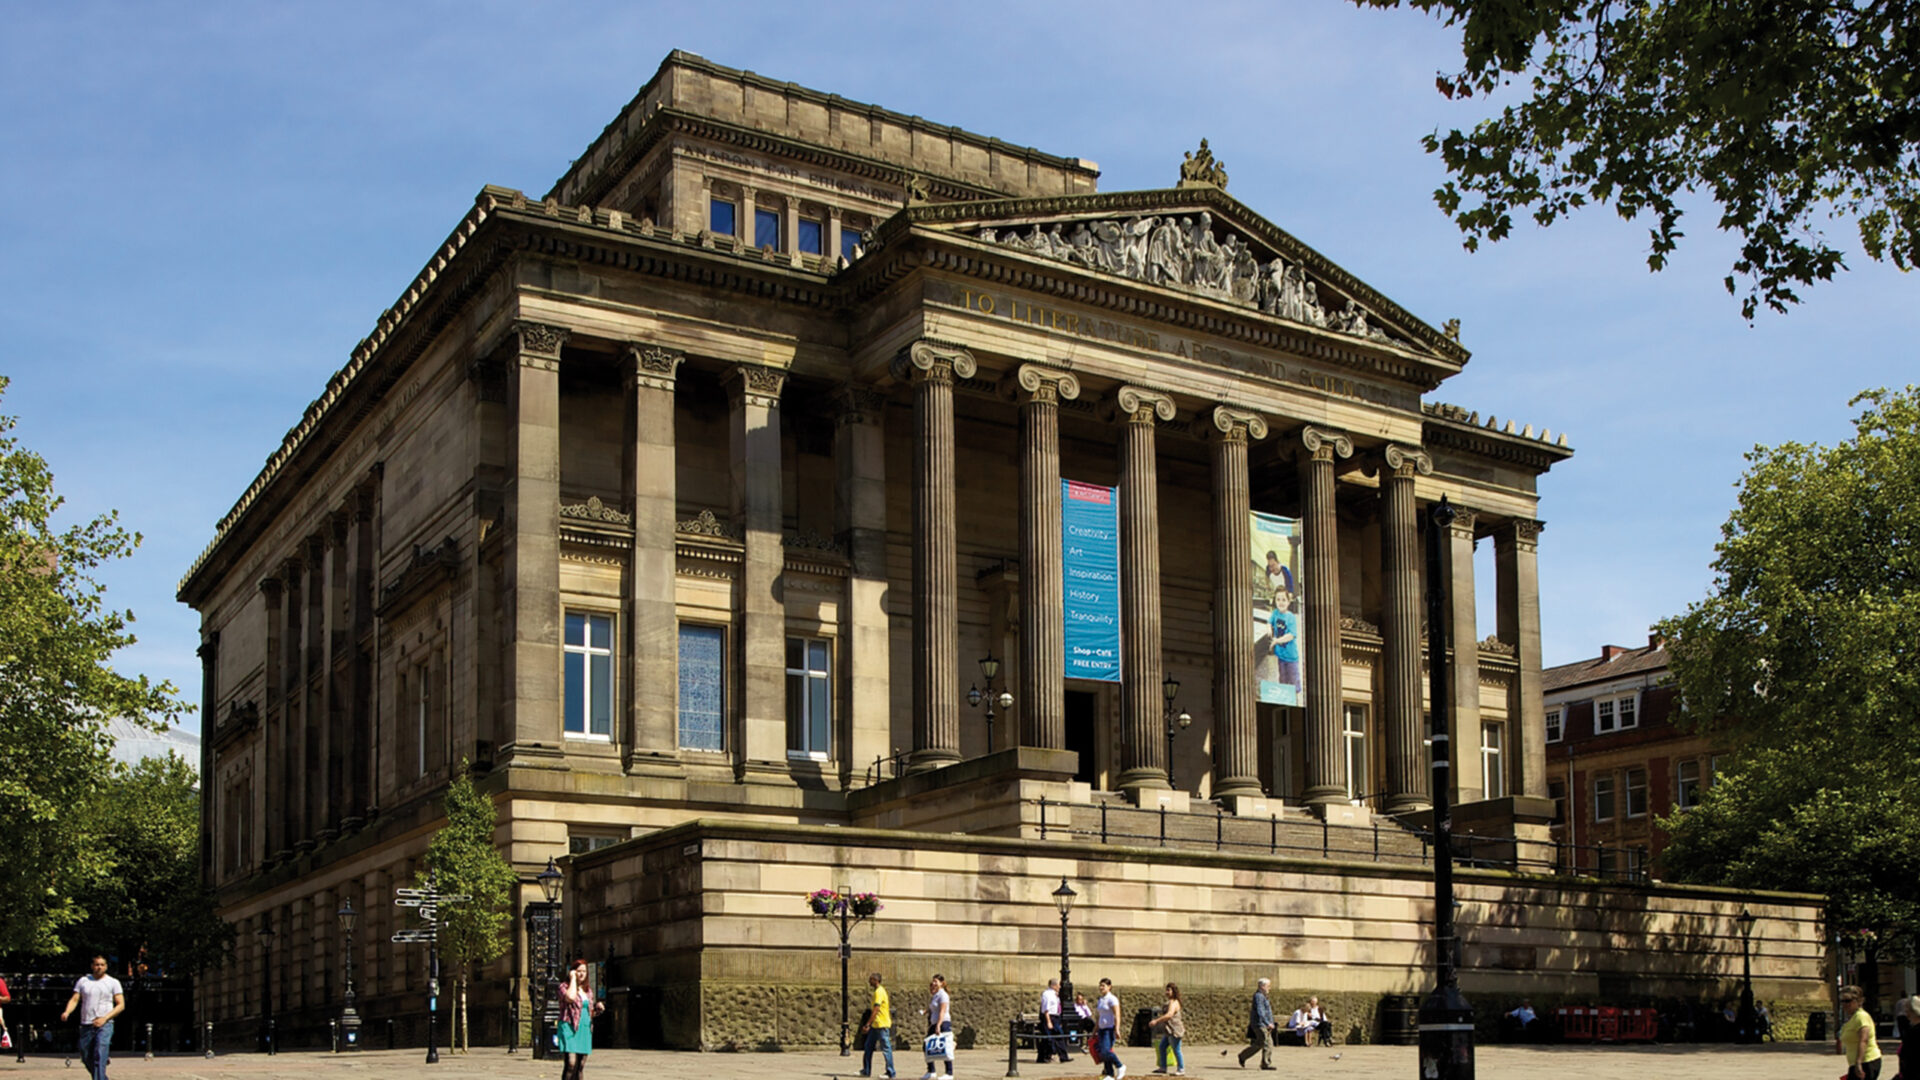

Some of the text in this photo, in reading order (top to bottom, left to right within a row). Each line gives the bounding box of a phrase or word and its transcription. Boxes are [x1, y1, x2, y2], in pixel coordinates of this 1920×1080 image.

[961, 289, 995, 315] TO
[1011, 300, 1160, 352] LITERATURE
[1175, 339, 1234, 368] ARTS
[1068, 524, 1110, 541] Creativity
[1069, 546, 1083, 557] Art
[1069, 568, 1114, 581] Inspiration
[1069, 589, 1100, 603] History
[1073, 646, 1091, 656] Shop
[1073, 659, 1112, 669] FREE ENTRY
